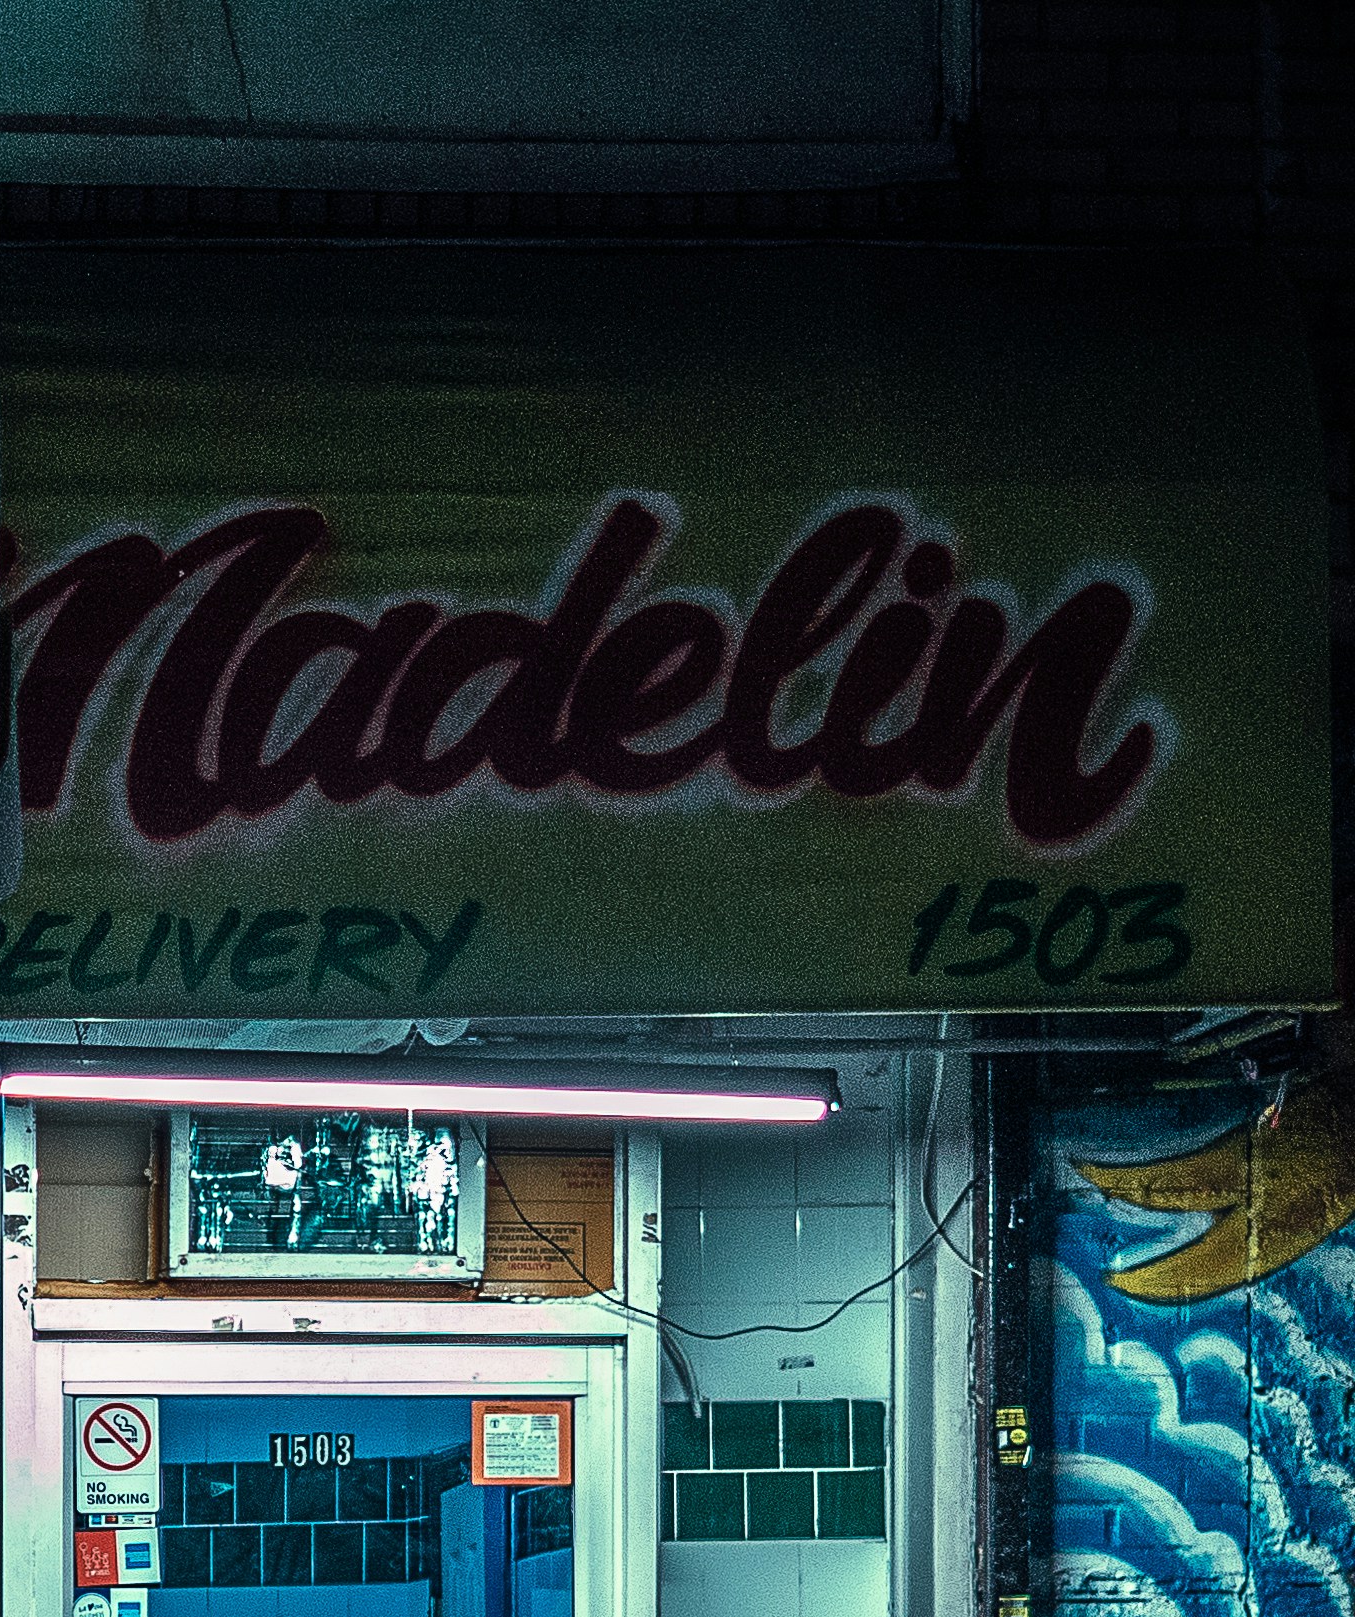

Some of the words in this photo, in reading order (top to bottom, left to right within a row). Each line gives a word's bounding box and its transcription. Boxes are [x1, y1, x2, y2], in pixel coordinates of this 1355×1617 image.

[909, 880, 1193, 987] 1503
[273, 1435, 351, 1467] 1503
[86, 1482, 106, 1493] NO
[86, 1494, 150, 1505] SMOKING
